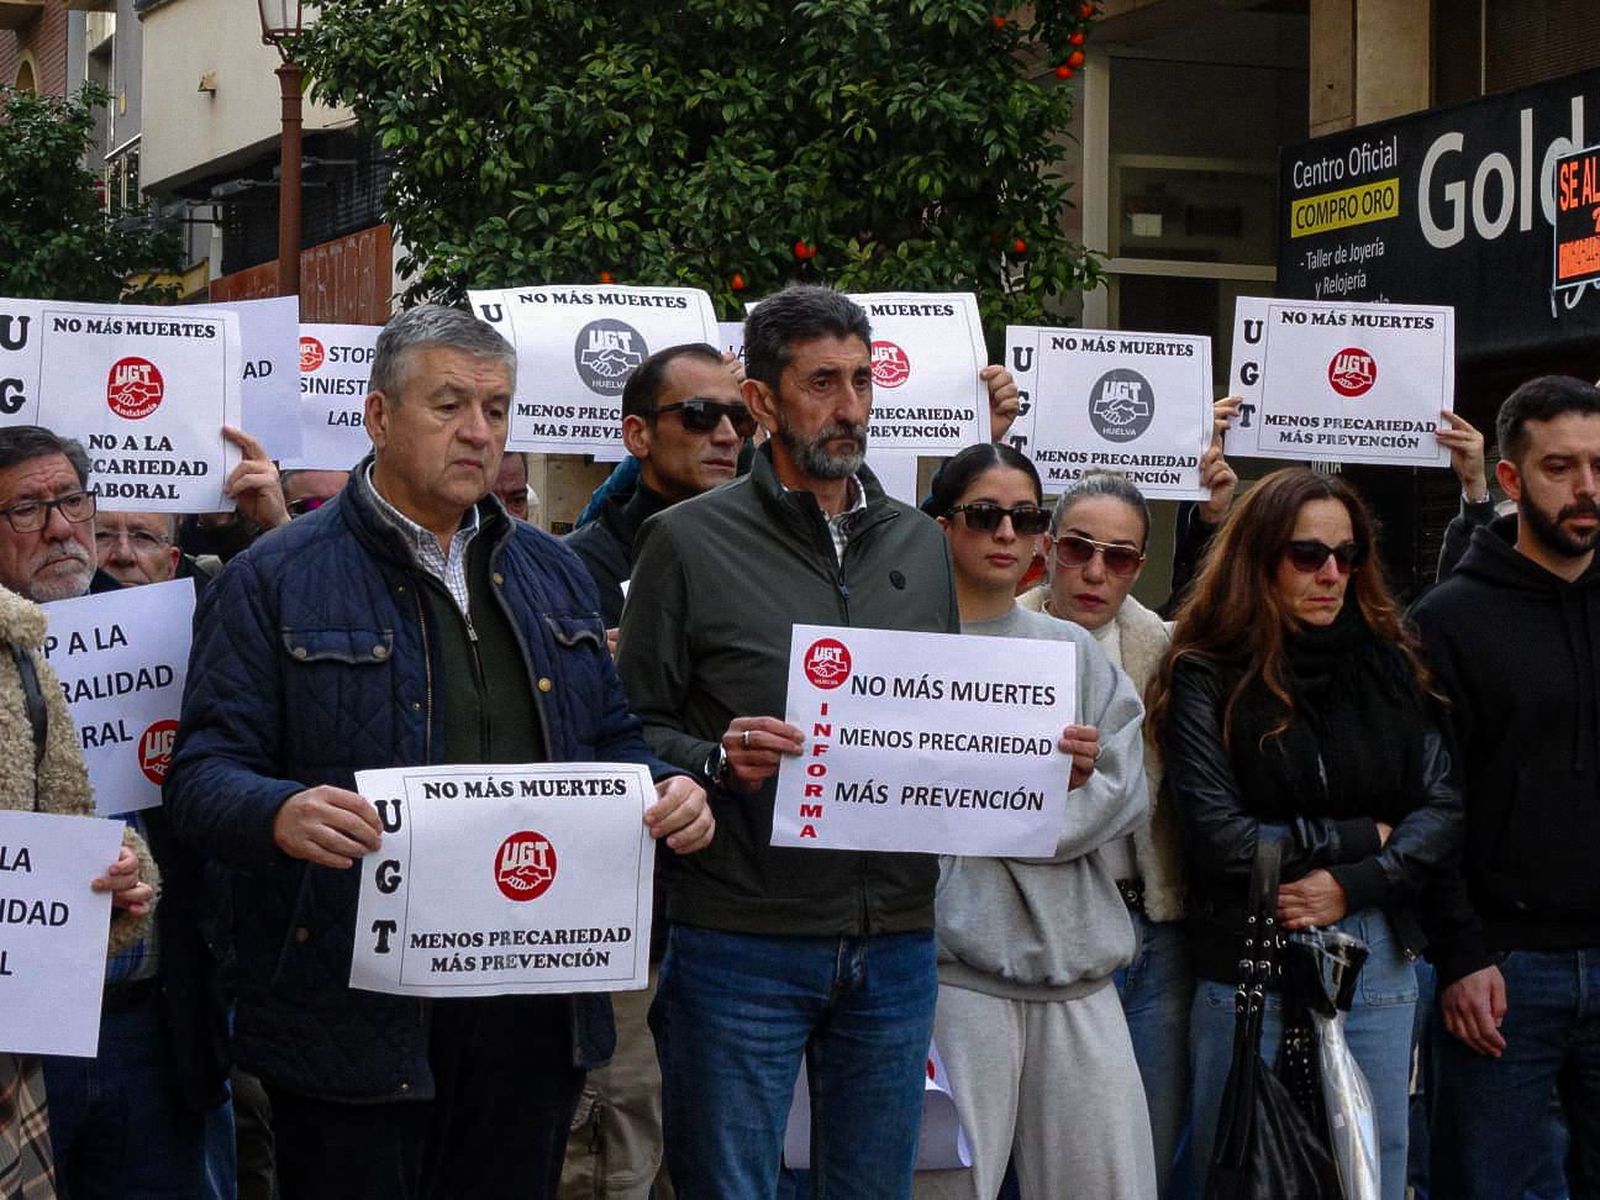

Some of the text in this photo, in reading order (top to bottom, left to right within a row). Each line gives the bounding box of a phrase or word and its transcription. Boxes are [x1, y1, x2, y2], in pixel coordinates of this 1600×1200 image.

[1294, 135, 1397, 189] Centro Oficial
[1560, 161, 1579, 211] SE
[1296, 186, 1394, 229] COMPRO ORO
[1306, 250, 1333, 270] Taller
[1334, 245, 1347, 265] de
[1349, 236, 1385, 264] Joyería
[1315, 268, 1367, 300] y Relojería
[519, 289, 688, 309] NO MÁS MUERTES
[871, 304, 954, 317] MUERTES
[1282, 310, 1435, 330] NO MÁS MUERTES
[53, 317, 216, 338] NO MÁS MUERTES
[589, 330, 632, 352] UGT
[1051, 336, 1194, 357] NO MÁS MUERTES
[329, 346, 376, 363] STOP
[1334, 354, 1372, 374] UGT
[116, 365, 151, 384] UGT
[592, 380, 627, 389] HUELV
[301, 377, 367, 396] SINIEST
[1102, 381, 1142, 402] UGT
[517, 403, 575, 418] MENOS
[533, 423, 623, 439] MAS PREVE
[1103, 428, 1137, 436] HUELVA
[1265, 415, 1437, 433] MENOS PRECARIEDAD
[89, 434, 174, 451] NO A LA
[1279, 430, 1419, 449] MÁS PREVENCIÓN
[88, 459, 208, 476] CARIEDAD
[1035, 450, 1198, 467] MENOS PRECARIEDAD
[1049, 468, 1181, 484] MAS ENCIÓN
[92, 482, 180, 500] ABORAL
[69, 632, 88, 655] A
[95, 624, 128, 650] LA
[813, 647, 842, 662] UGT
[60, 664, 174, 704] RALIDAD
[851, 674, 1056, 706] NO MÁS MUERTES
[145, 730, 176, 758] UG
[840, 728, 1052, 756] MENOS PRECARIEDAD
[424, 776, 627, 799] NO MÁS MUERTES
[835, 779, 1044, 811] MÁS PREVENCIÓN
[503, 842, 549, 869] UGT
[410, 927, 632, 949] MENOS PRECARIEDAD
[431, 949, 610, 972] MÁS PREVENCIÓN
